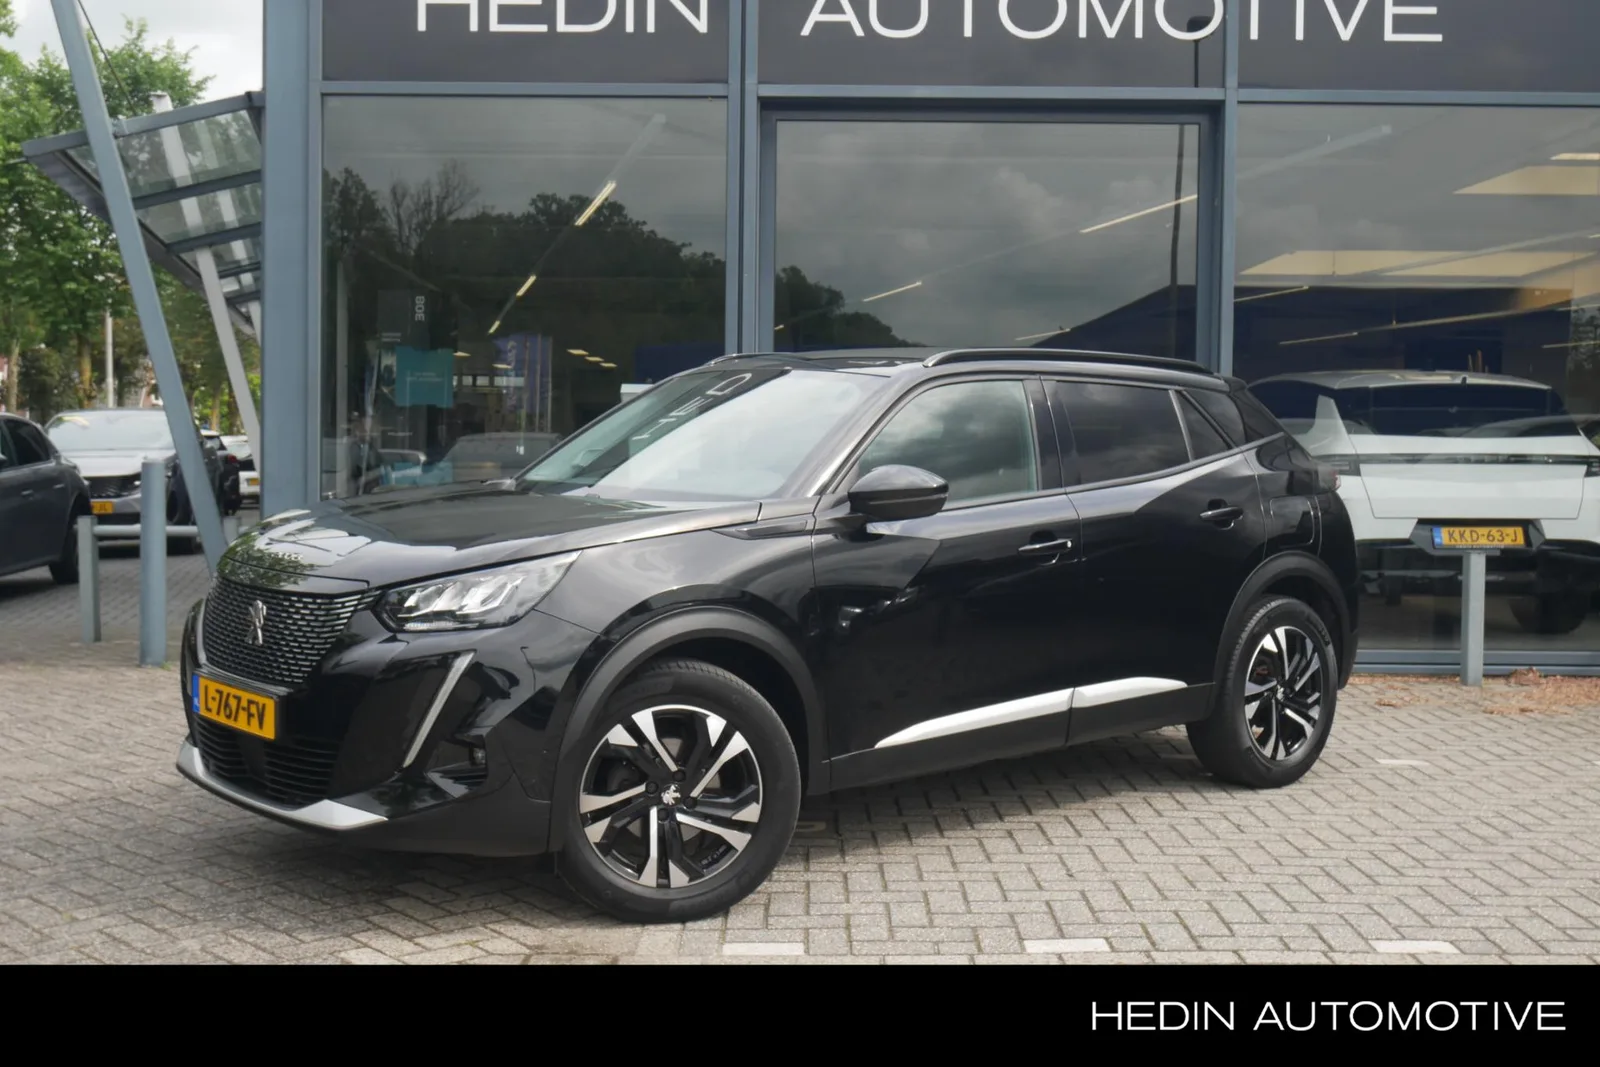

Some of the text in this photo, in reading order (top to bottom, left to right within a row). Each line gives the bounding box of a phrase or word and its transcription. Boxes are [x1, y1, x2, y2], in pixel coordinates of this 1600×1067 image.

[414, 295, 426, 322] 308
[1447, 528, 1519, 543] KKD-63-J
[203, 684, 267, 731] L-767-FV
